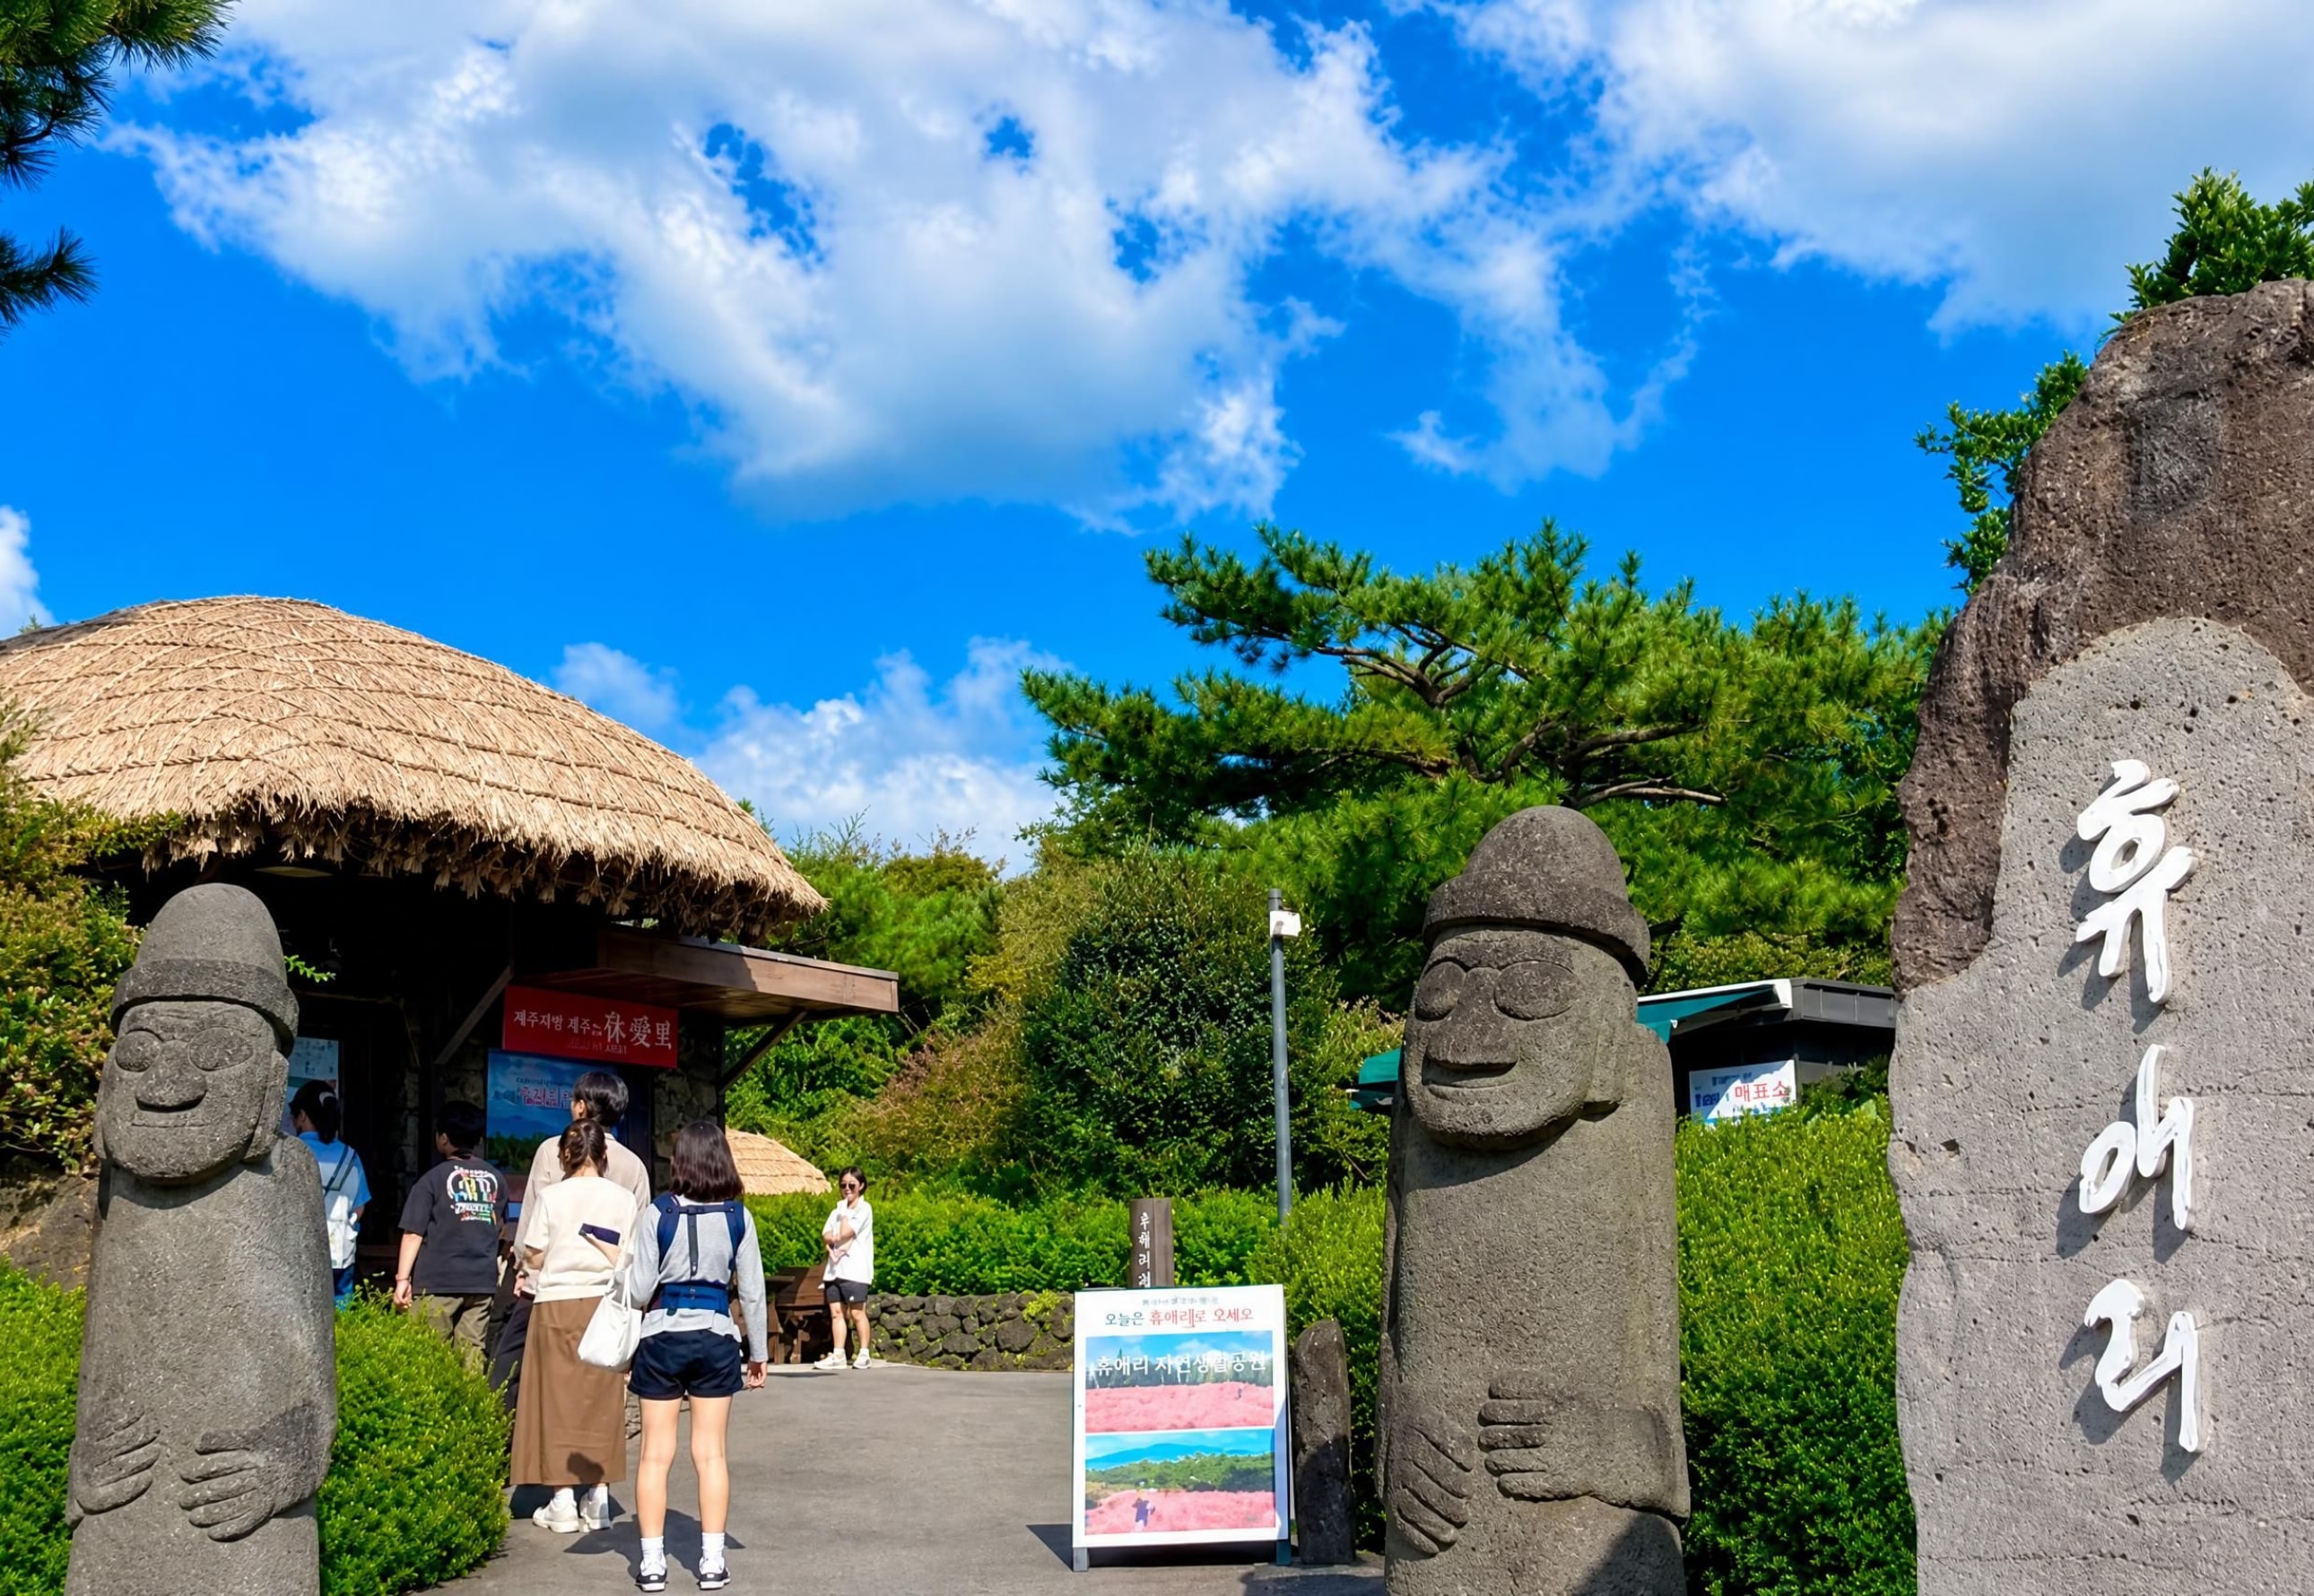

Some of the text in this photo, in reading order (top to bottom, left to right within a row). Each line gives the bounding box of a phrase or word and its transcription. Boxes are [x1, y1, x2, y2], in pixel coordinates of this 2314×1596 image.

[1735, 1080, 1789, 1103] 매표소
[1105, 1311, 1144, 1327] 오늘은
[1213, 1307, 1254, 1323] 오세오
[1096, 1354, 1149, 1377] 휴애리
